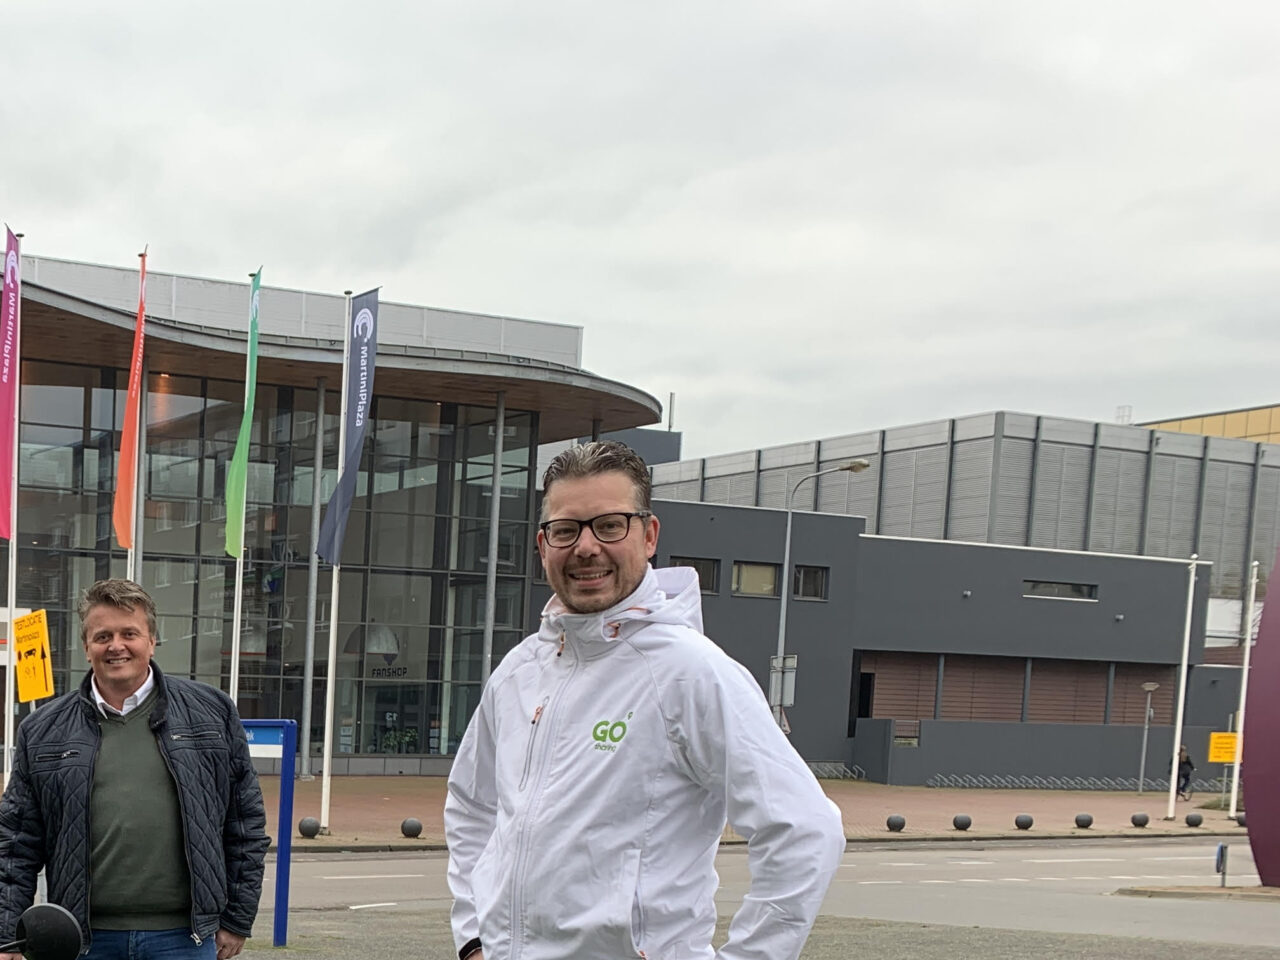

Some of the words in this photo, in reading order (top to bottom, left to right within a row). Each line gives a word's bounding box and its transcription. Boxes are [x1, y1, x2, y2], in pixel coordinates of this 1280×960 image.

[355, 346, 368, 427] MartiniPlaza
[371, 667, 408, 678] FANSHOP
[592, 720, 627, 743] GO
